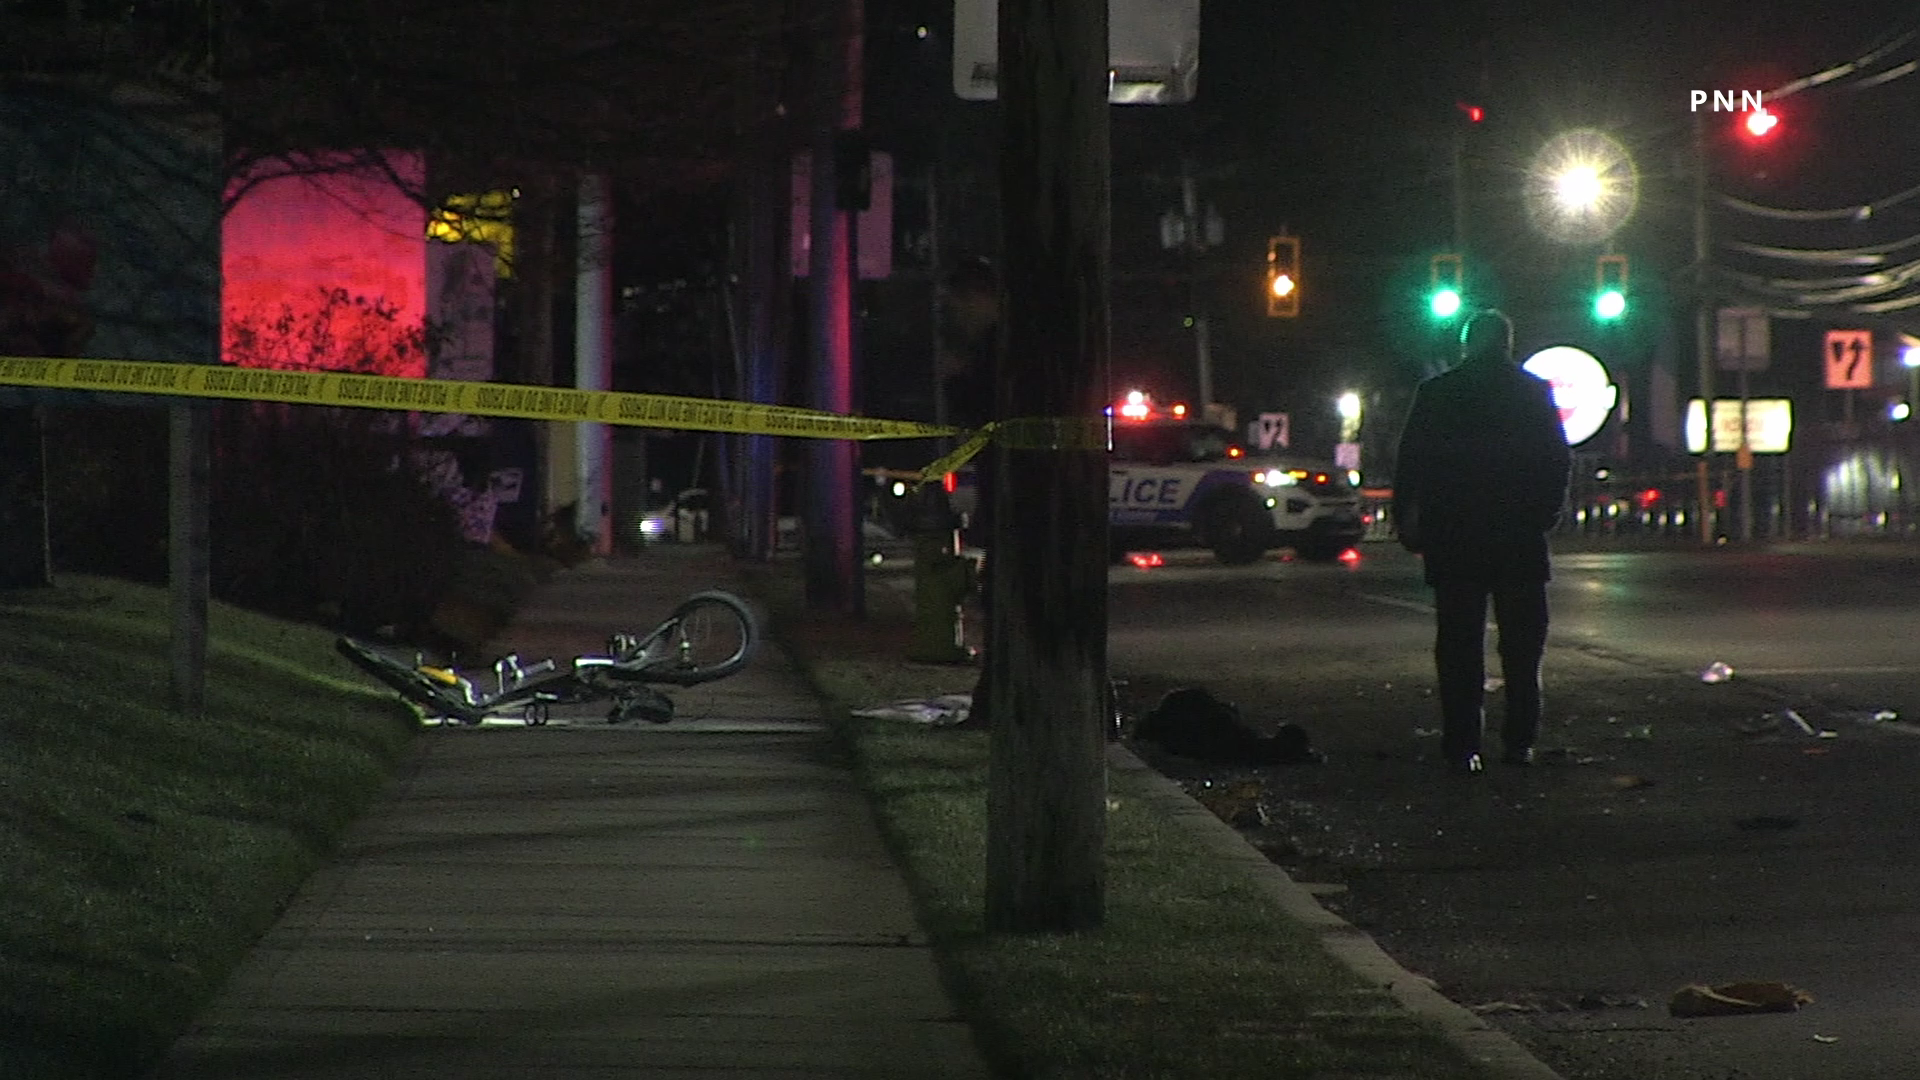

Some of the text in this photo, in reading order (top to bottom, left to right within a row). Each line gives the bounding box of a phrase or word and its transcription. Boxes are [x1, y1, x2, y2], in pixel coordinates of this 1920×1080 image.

[75, 364, 100, 383] CROSS
[100, 365, 117, 384] NOT
[130, 367, 149, 386] LINE
[149, 367, 176, 387] POLICE
[205, 370, 231, 391] CROSS
[232, 372, 249, 392] NOT
[262, 374, 281, 395] LINE
[282, 375, 310, 395] POLICE
[340, 377, 366, 400] CROSS
[367, 380, 384, 401] NOT
[398, 382, 418, 403] LINE
[418, 383, 447, 405] POLICE
[478, 386, 505, 409] CROSS
[506, 389, 523, 411] NOT
[539, 391, 559, 412] LINE
[560, 392, 589, 415] POLICE
